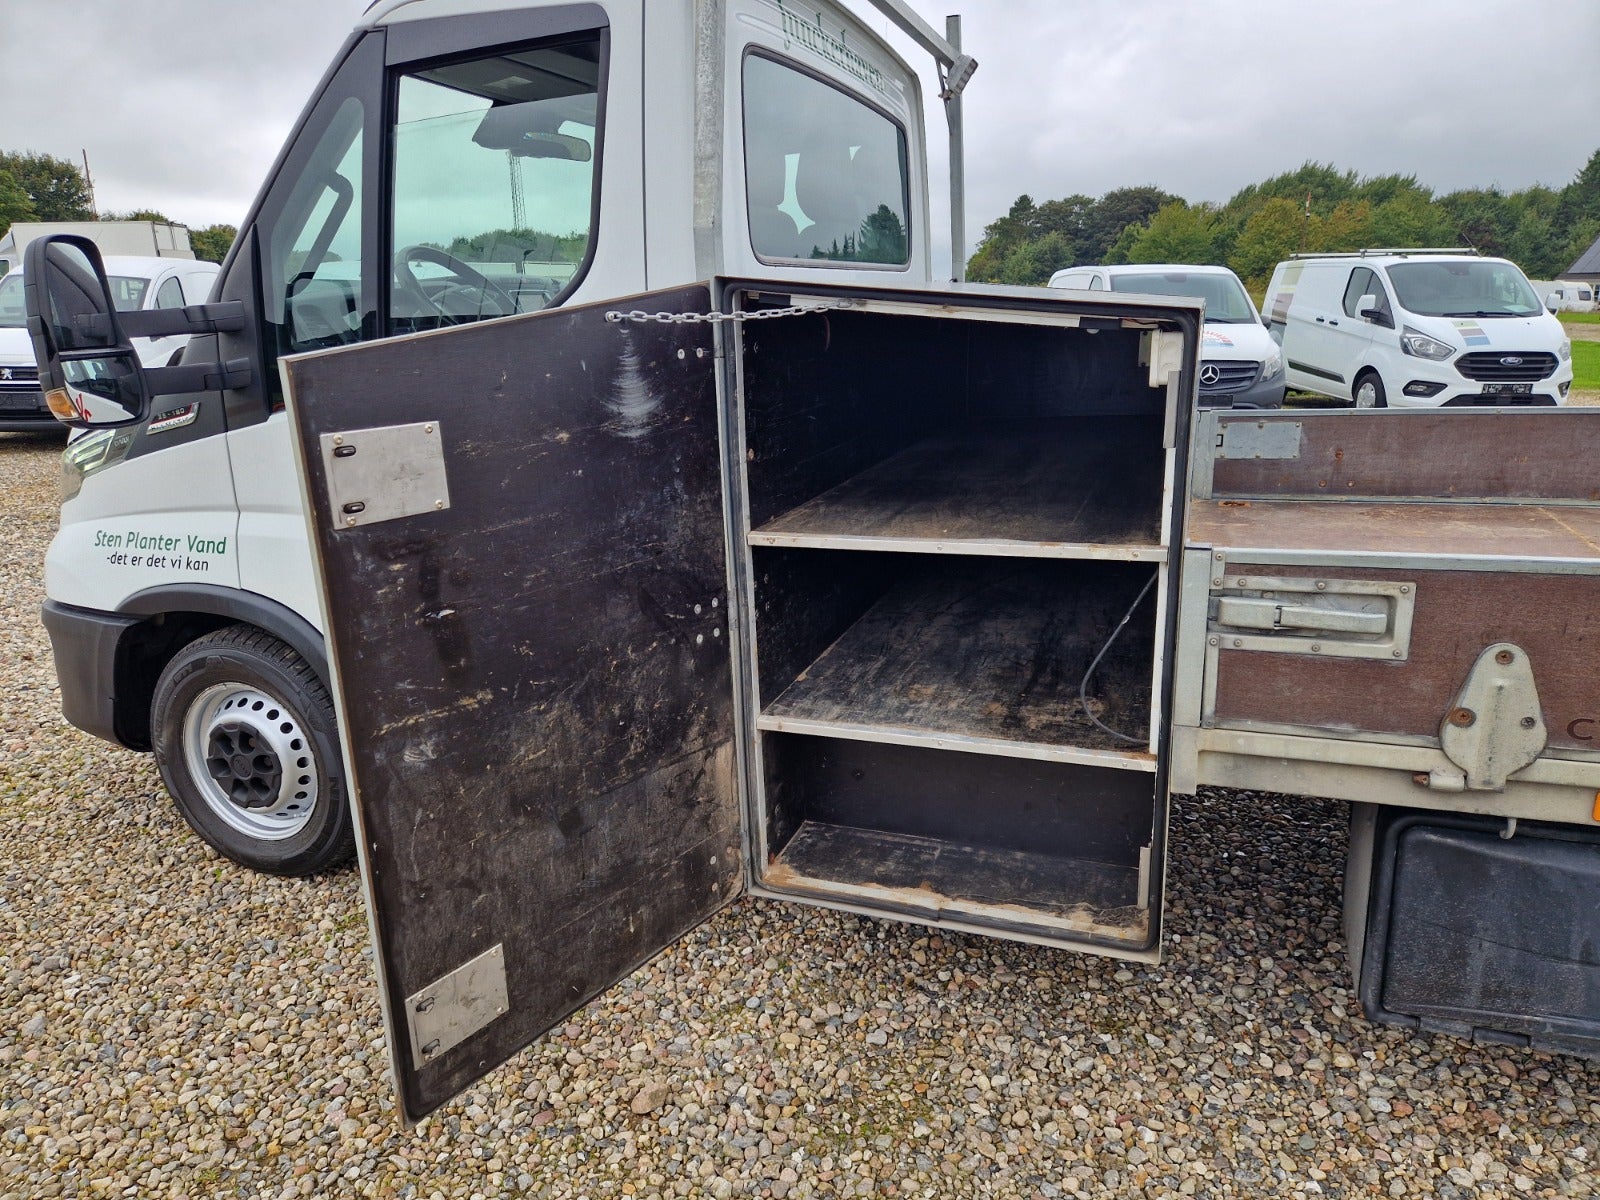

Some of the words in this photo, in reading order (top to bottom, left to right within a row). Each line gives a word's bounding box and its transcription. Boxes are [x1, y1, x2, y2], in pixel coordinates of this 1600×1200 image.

[95, 530, 121, 547] Sten
[126, 532, 181, 551] Planter
[187, 535, 226, 554] Vand
[106, 551, 127, 566] -det
[131, 555, 143, 567] er
[146, 553, 166, 569] det
[170, 555, 182, 570] vi
[186, 557, 208, 571] kan
